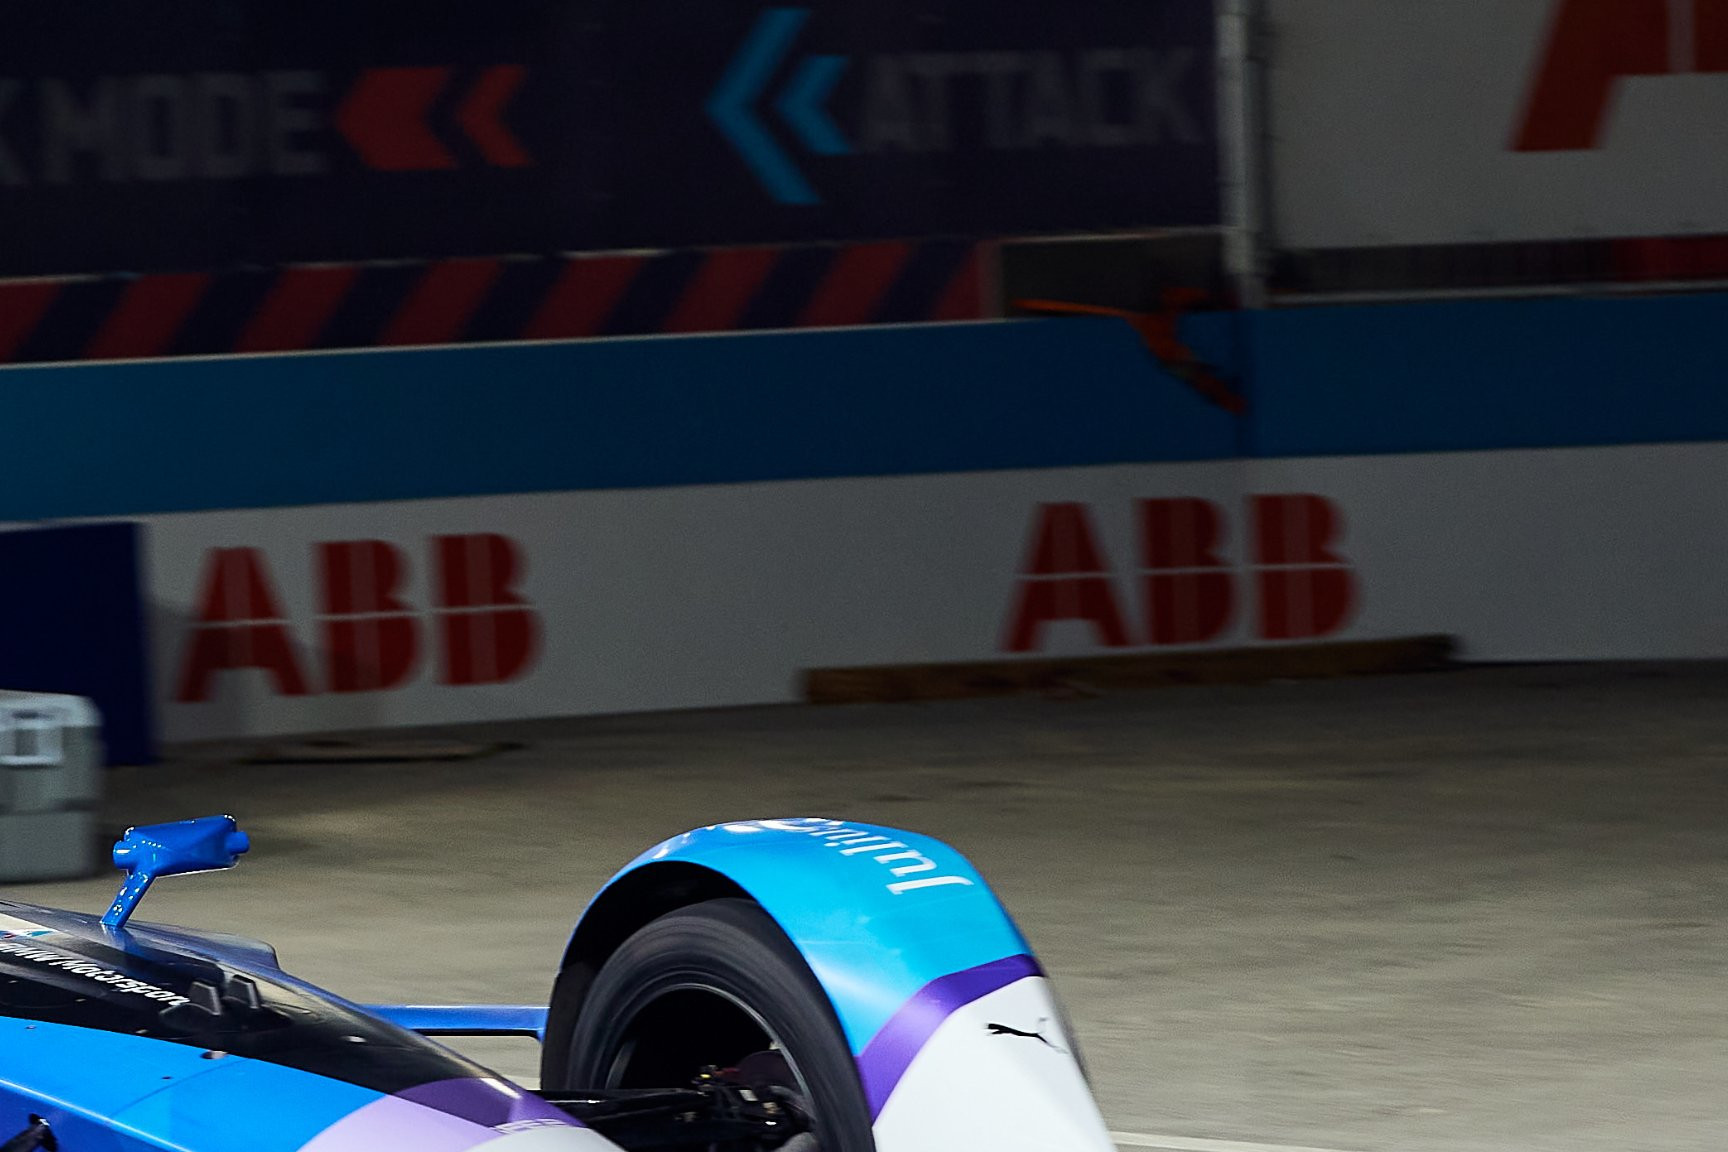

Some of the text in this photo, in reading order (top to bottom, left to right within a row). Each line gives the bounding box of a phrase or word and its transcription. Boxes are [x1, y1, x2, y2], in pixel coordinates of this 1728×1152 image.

[38, 69, 332, 185] MODE
[854, 46, 1206, 153] ATTACK
[175, 531, 545, 704] ABB
[998, 492, 1366, 655] ABB
